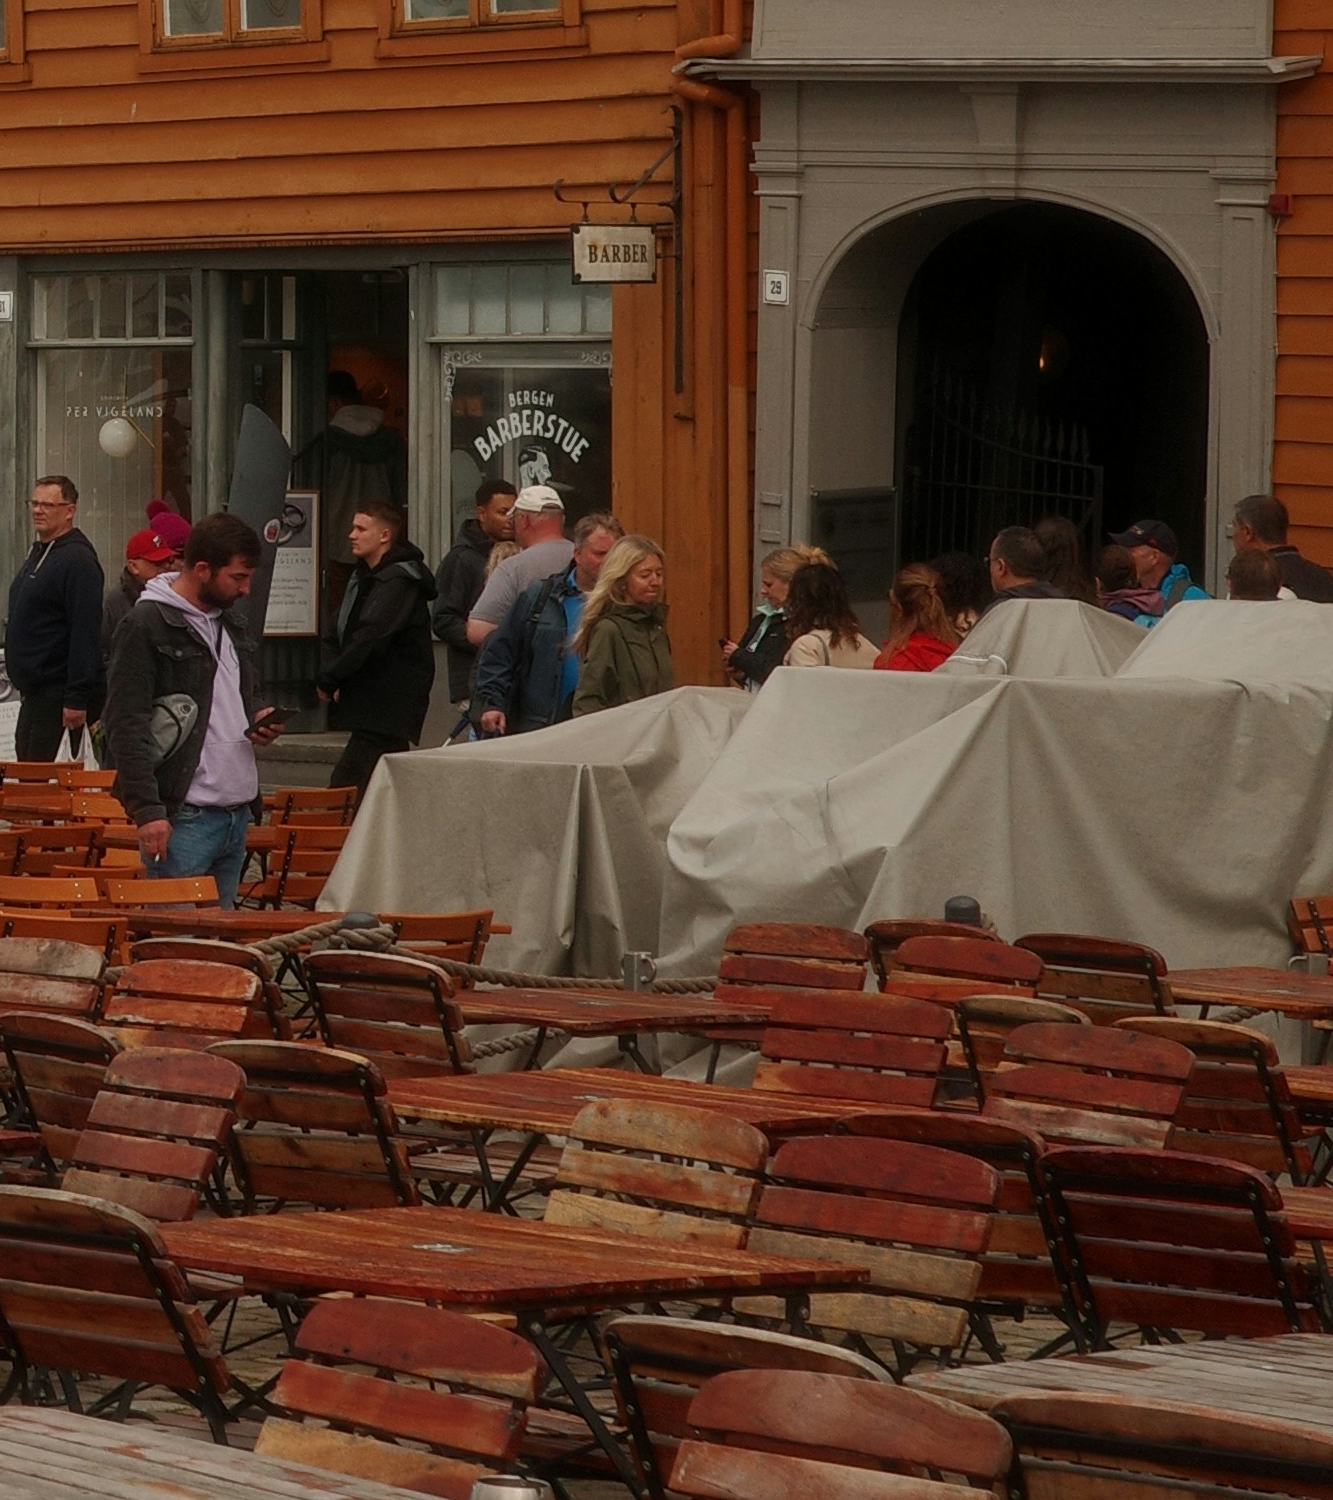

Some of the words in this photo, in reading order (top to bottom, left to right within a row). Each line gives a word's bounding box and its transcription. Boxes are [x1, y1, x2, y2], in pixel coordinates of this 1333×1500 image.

[587, 244, 648, 264] BARBER
[769, 280, 783, 295] 29
[508, 390, 554, 408] BERGEN
[66, 406, 88, 418] PER
[96, 406, 164, 418] VIGELAND
[473, 409, 590, 463] BARBERSTUE
